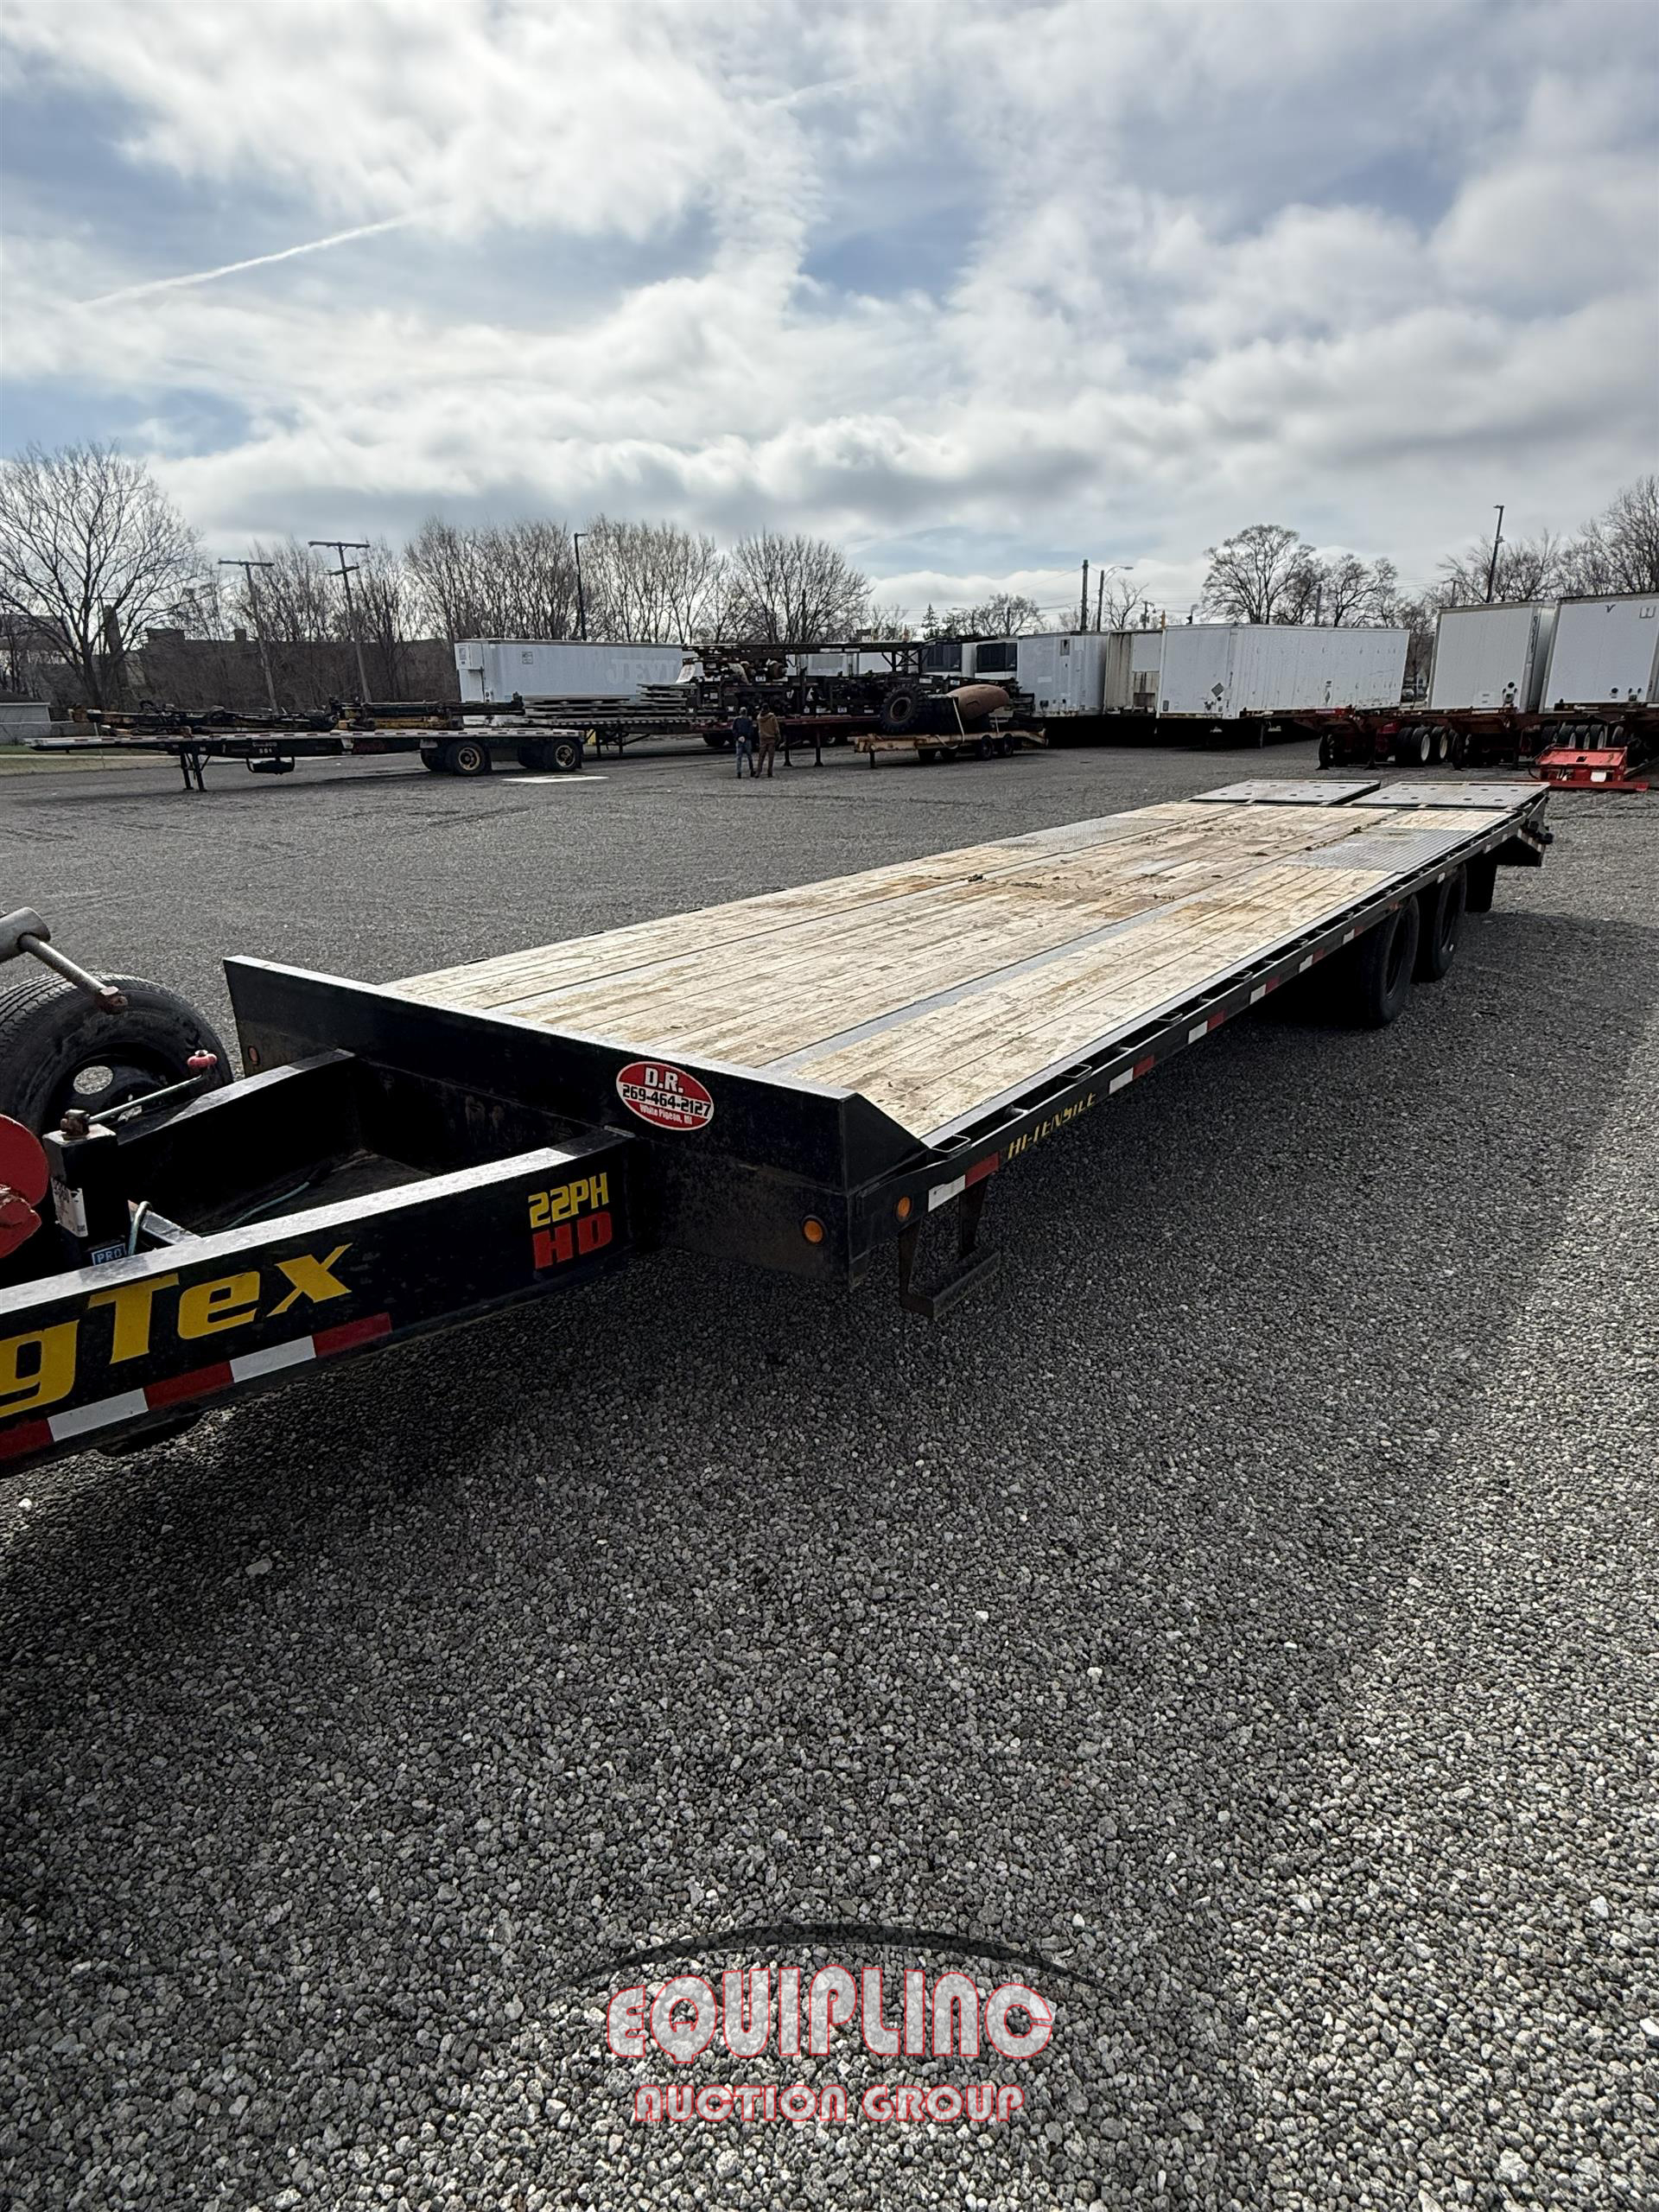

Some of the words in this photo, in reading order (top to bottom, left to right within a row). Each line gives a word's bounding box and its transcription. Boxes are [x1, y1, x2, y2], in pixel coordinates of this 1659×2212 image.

[645, 1067, 684, 1094] D.R.
[622, 1084, 711, 1117] 269-464-2127
[528, 1172, 609, 1229] 22PH
[97, 1248, 122, 1263] PRO
[532, 1211, 613, 1269] HD
